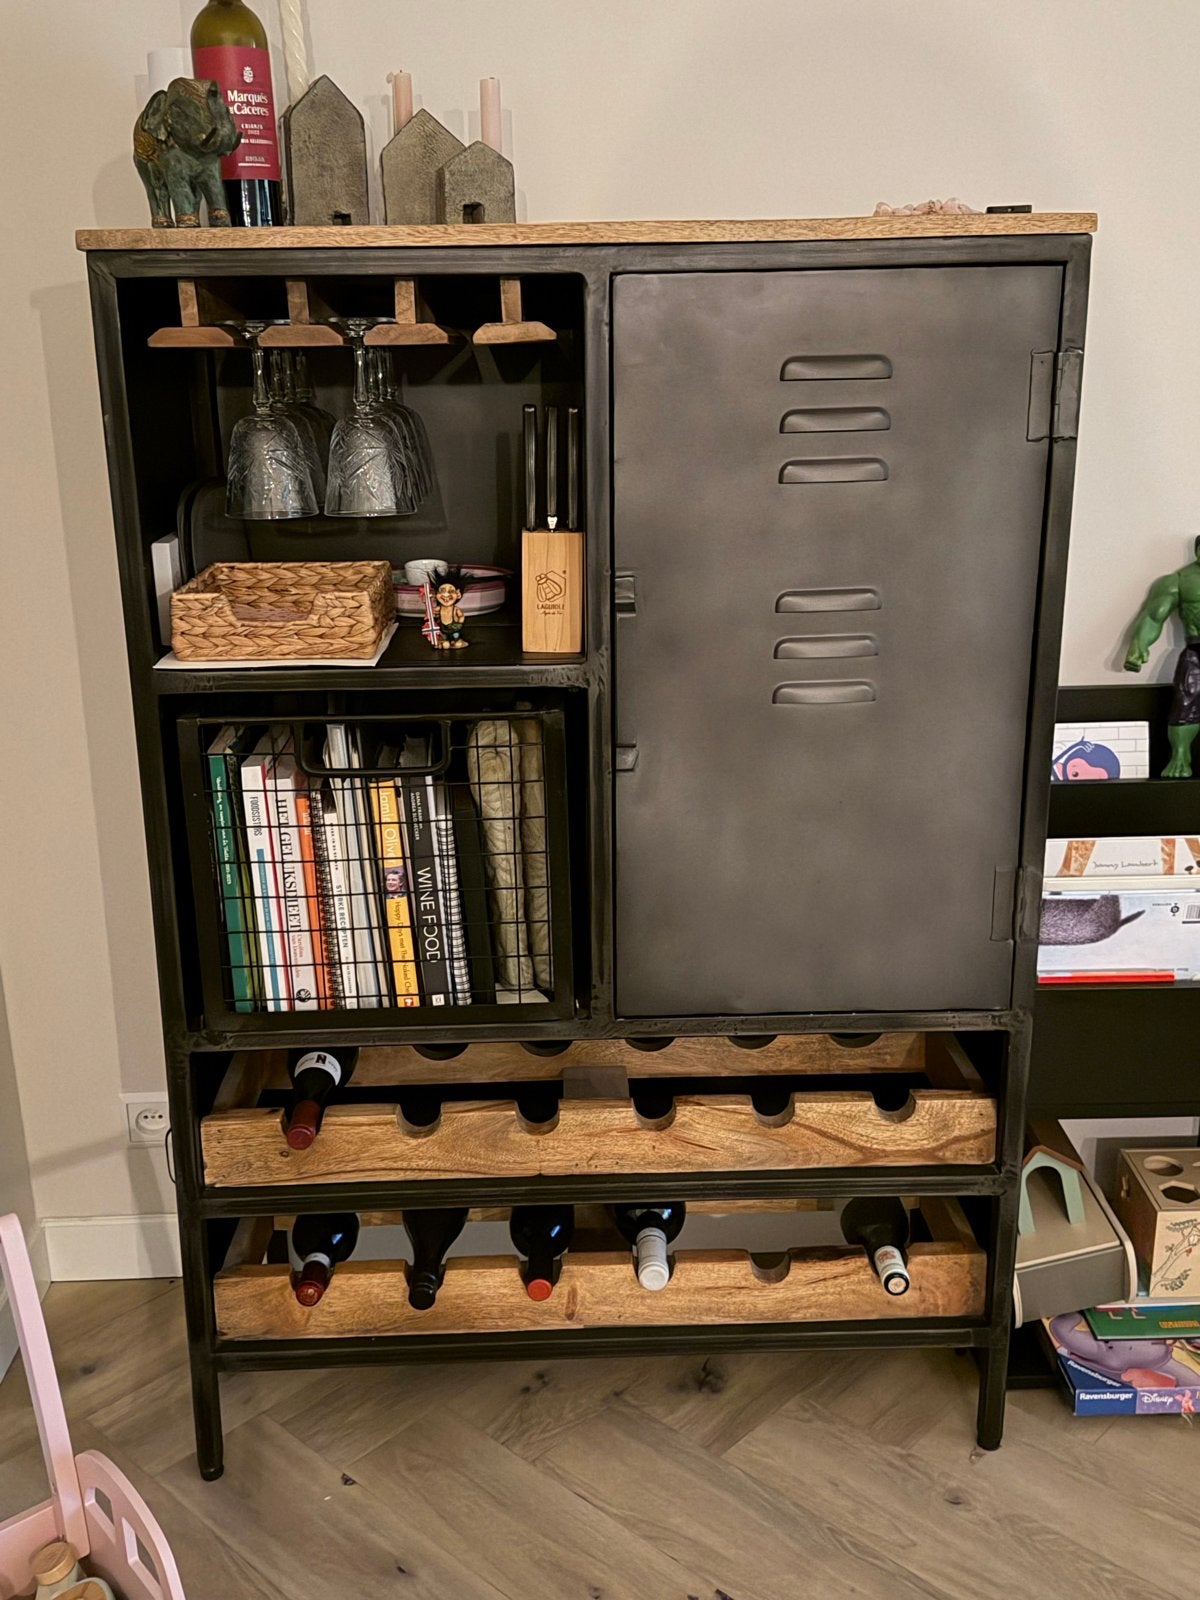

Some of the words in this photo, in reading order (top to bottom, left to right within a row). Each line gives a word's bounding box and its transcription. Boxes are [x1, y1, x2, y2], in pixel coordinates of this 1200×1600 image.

[227, 90, 268, 105] Marqués
[233, 103, 269, 116] Cáceres
[249, 796, 263, 836] FOODSISTRS
[335, 884, 344, 911] STRKE
[416, 866, 434, 911] WINE
[392, 900, 402, 920] Happy
[421, 914, 440, 964] FOOD
[316, 1054, 327, 1065] N
[1067, 1360, 1122, 1387] Ravensburger
[1079, 1392, 1134, 1401] Ravensburger
[1140, 1392, 1173, 1405] Disney
